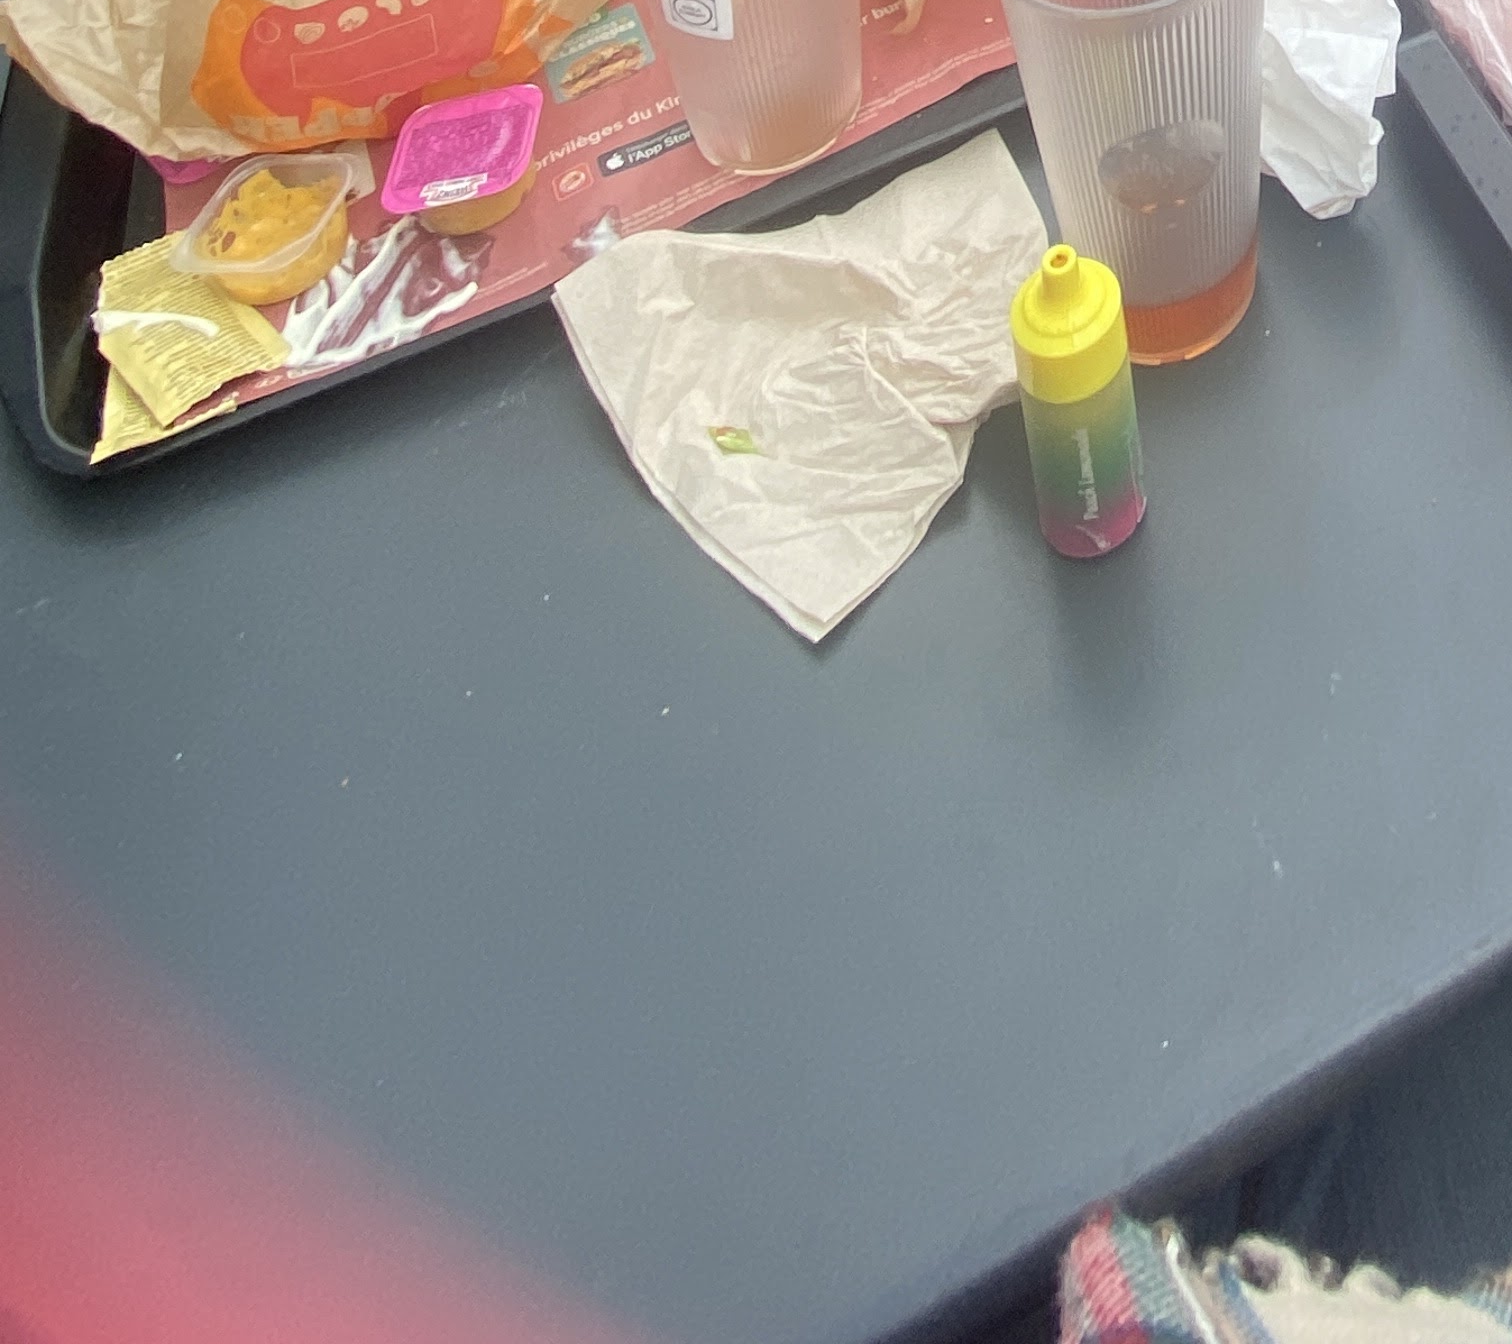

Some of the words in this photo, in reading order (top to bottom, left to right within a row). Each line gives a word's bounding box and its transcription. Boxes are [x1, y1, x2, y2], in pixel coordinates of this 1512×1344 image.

[627, 106, 653, 127] du
[628, 143, 663, 164] l'App
[663, 129, 693, 147] Stor
